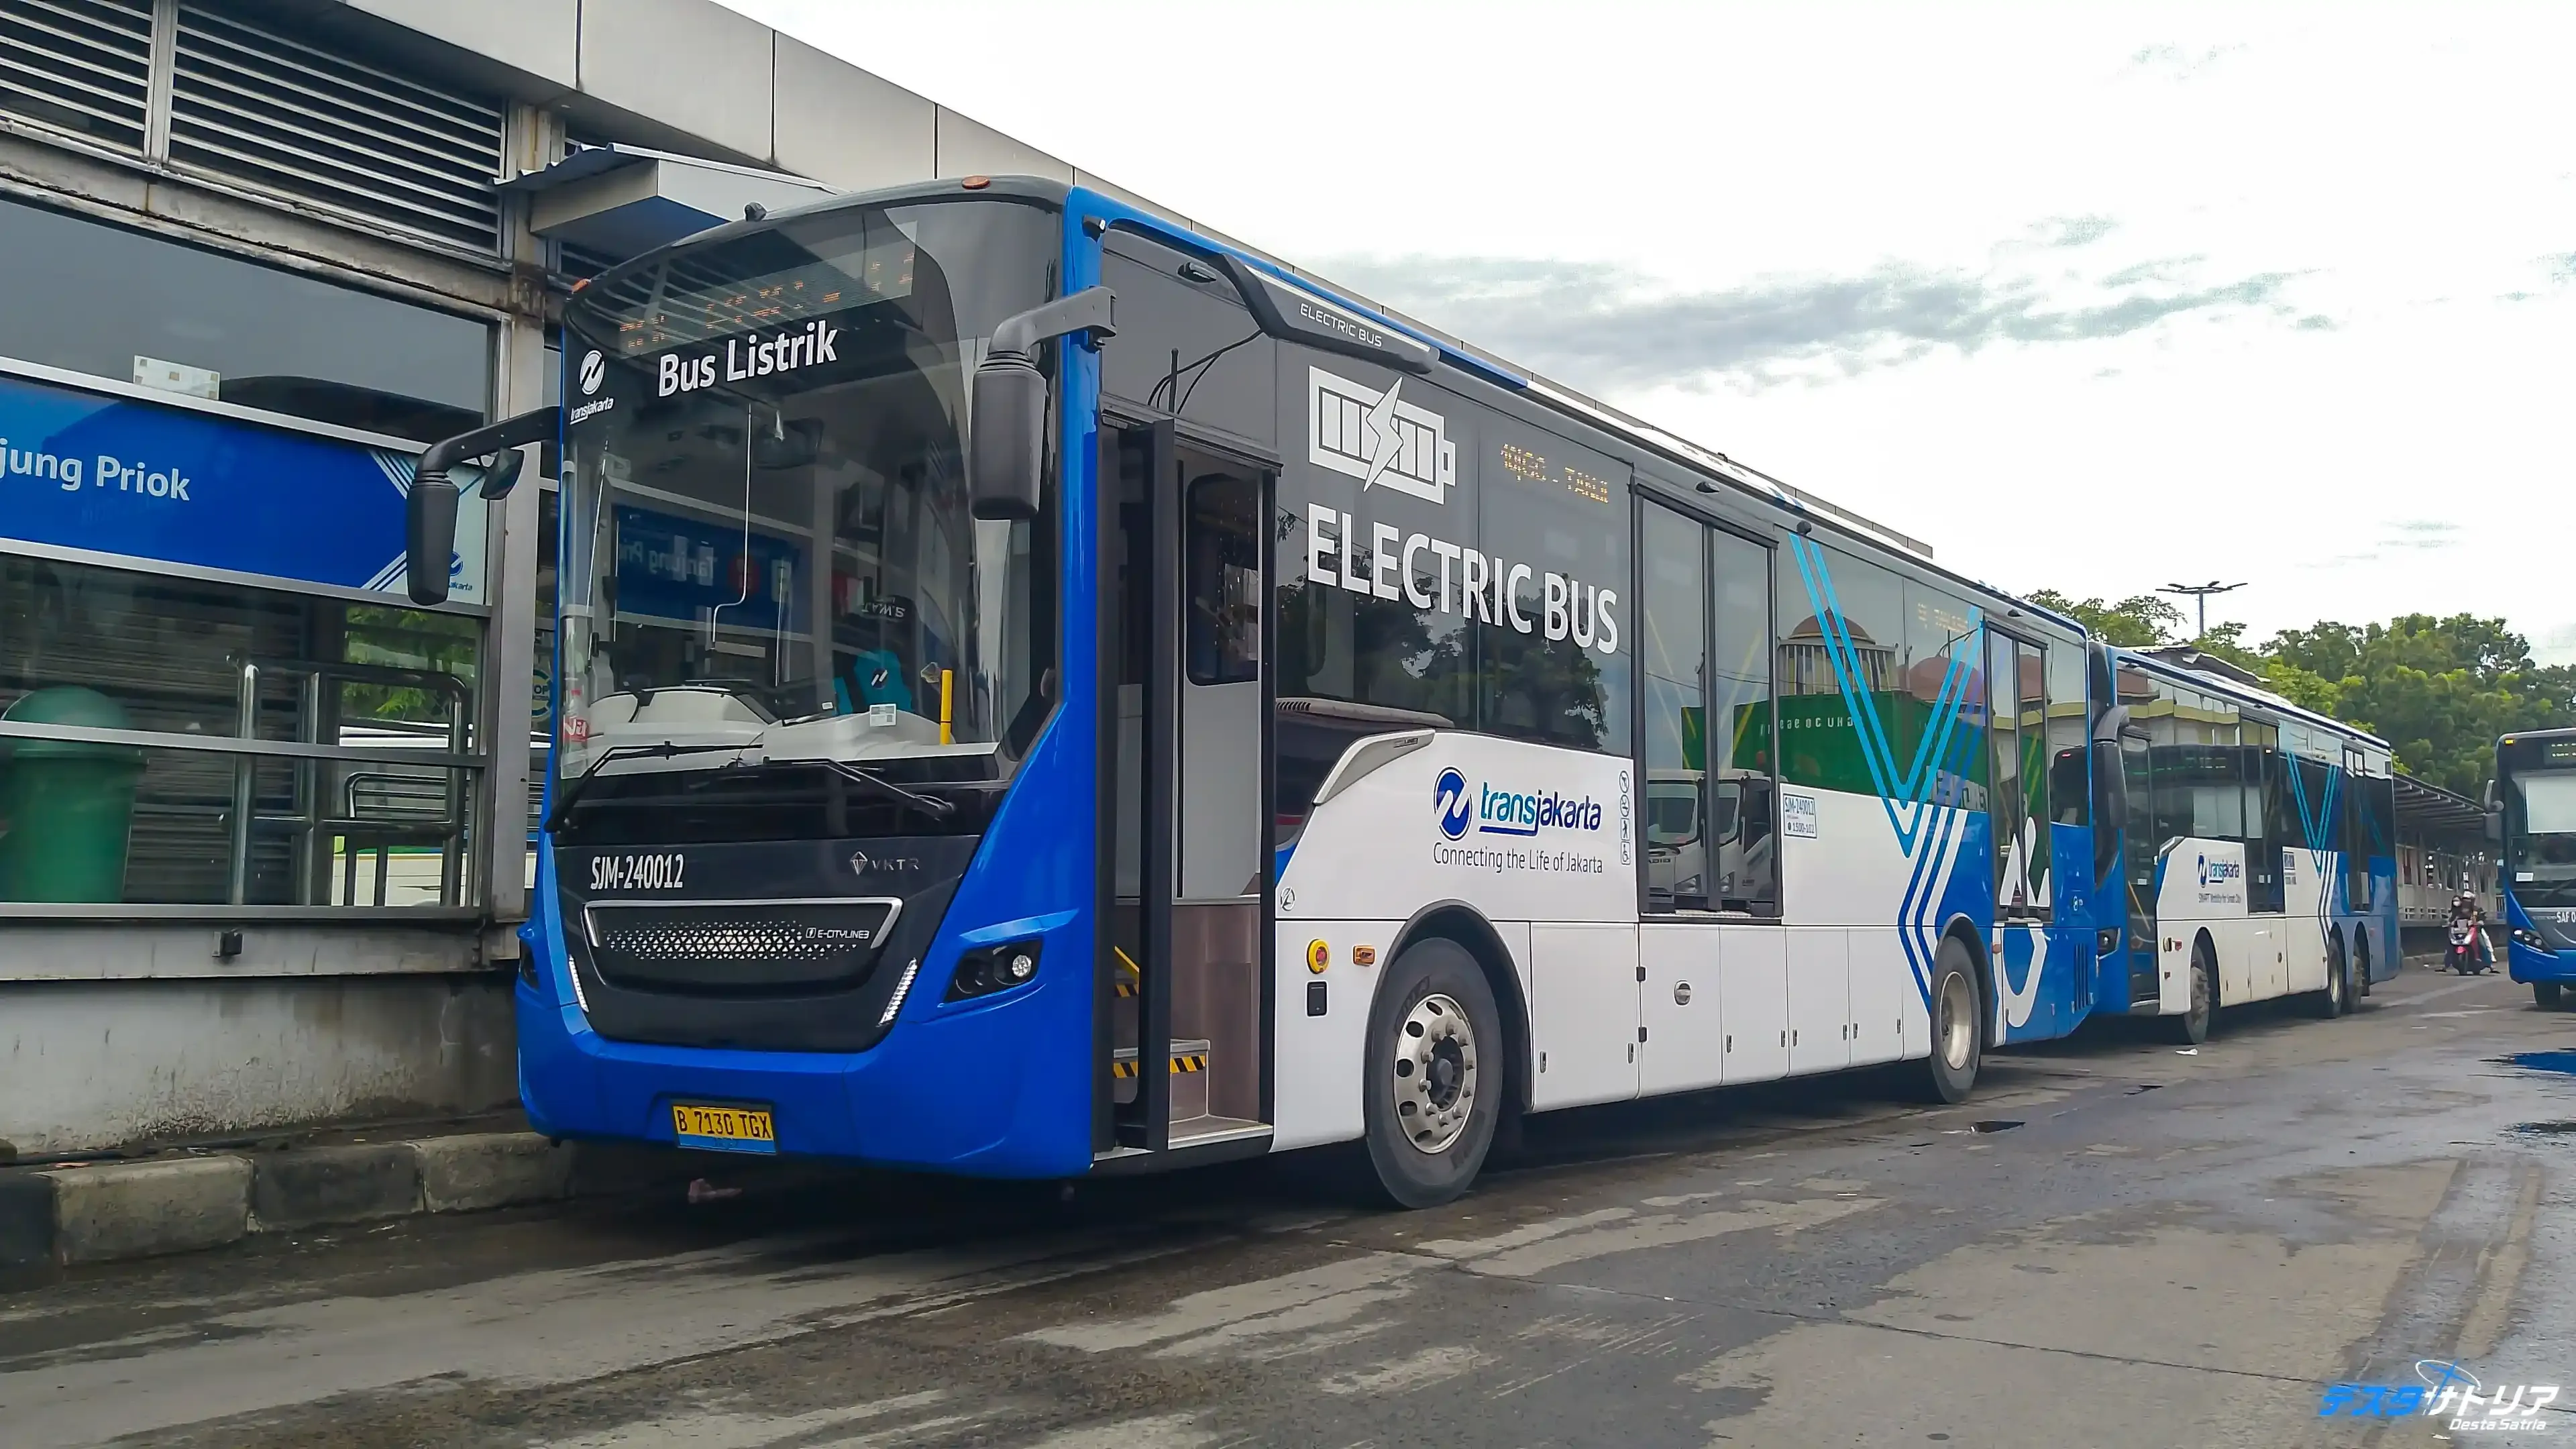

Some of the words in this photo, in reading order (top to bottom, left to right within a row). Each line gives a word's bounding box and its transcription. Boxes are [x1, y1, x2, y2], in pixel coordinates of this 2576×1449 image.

[1300, 303, 1356, 337] ELECTRIC
[1358, 327, 1383, 347] BUS
[658, 353, 716, 397] Bus
[727, 319, 838, 382] Listrik
[570, 396, 614, 425] transjakarta
[97, 455, 190, 501] Priok
[1308, 502, 1532, 634] ELECTRIC
[1544, 572, 1618, 655] BUS
[1478, 782, 1602, 837] transjakarta
[590, 853, 684, 890] SJM-240012
[871, 858, 920, 871] VKTR
[1433, 842, 1503, 873] Connecting
[1507, 848, 1525, 869] the
[1529, 849, 1550, 871] Life
[1553, 851, 1564, 871] of
[1565, 852, 1603, 873] Jakarta
[2557, 911, 2570, 924] SAF
[677, 1110, 688, 1132] B
[694, 1111, 734, 1135] 7130
[739, 1114, 771, 1138] TGX
